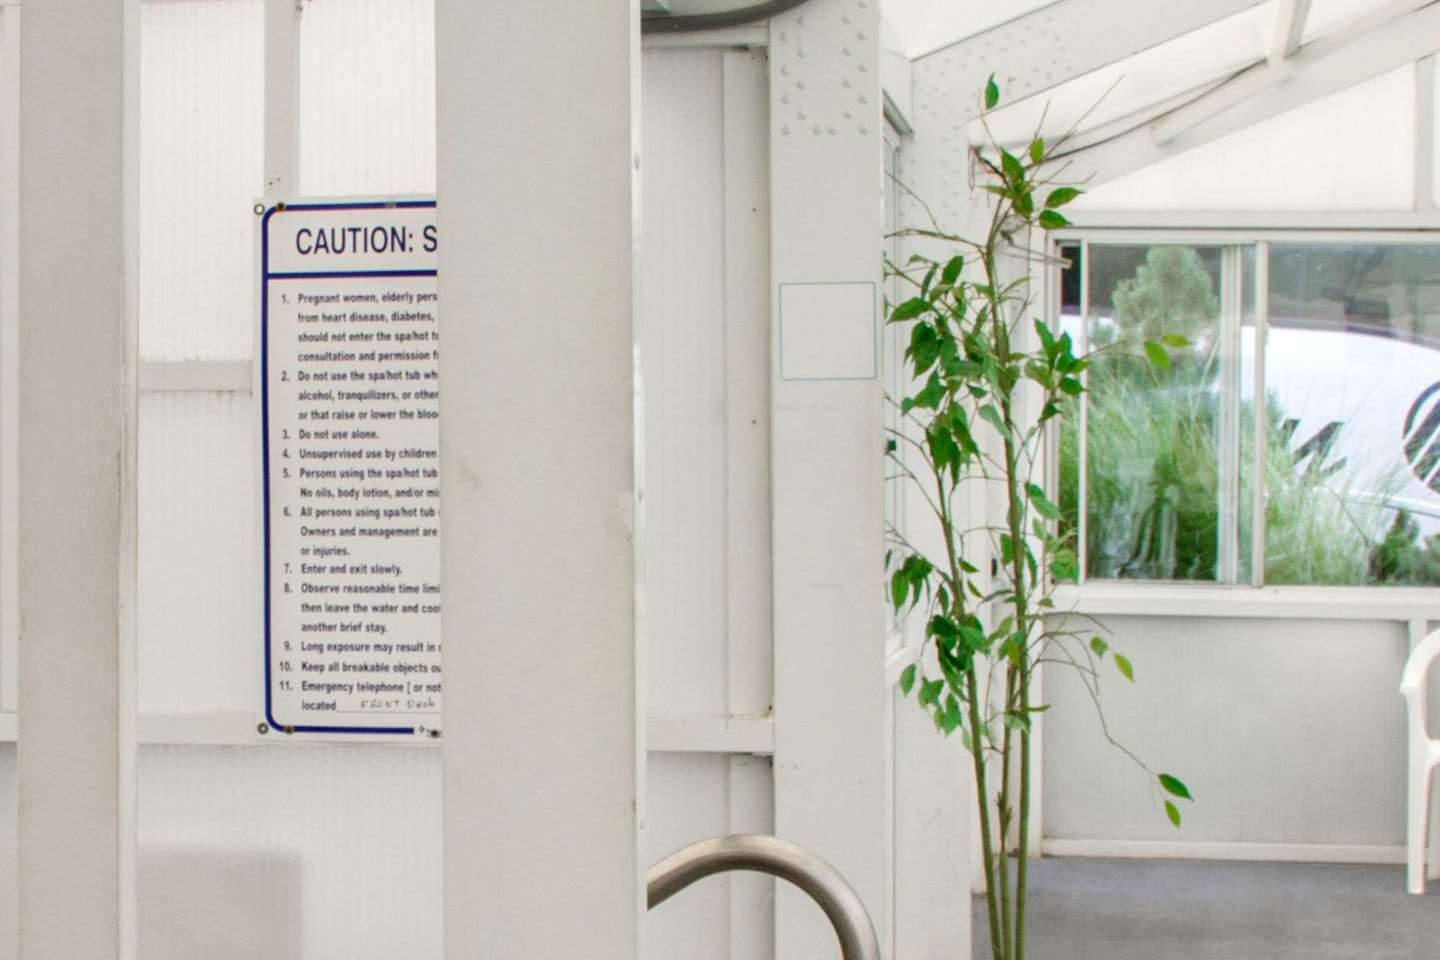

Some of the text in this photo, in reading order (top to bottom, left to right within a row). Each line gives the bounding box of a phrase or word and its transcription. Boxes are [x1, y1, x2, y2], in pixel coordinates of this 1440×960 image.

[296, 225, 414, 256] CAUTION:
[297, 293, 340, 306] Pregnant
[342, 294, 379, 303] women,
[381, 292, 414, 304] elderly
[297, 311, 435, 323] from heart disease, diabetes,
[297, 332, 329, 342] should
[330, 332, 347, 342] not
[348, 332, 374, 342] enter
[376, 331, 392, 341] the
[297, 352, 356, 362] consultation
[358, 351, 376, 361] and
[378, 350, 430, 363] permission
[297, 370, 311, 381] Do
[312, 372, 329, 381] not
[330, 373, 347, 381] use
[350, 370, 366, 381] the
[404, 370, 421, 380] tub
[297, 390, 439, 402] alcohol, tranquilizers, or other
[298, 412, 309, 420] or
[310, 410, 330, 420] that
[331, 409, 356, 420] raise
[358, 412, 368, 420] or
[370, 409, 397, 420] lower
[399, 409, 415, 419] the
[298, 429, 311, 439] Do
[312, 430, 329, 439] not
[331, 431, 348, 439] use
[350, 429, 381, 440] alone.
[299, 448, 363, 461] Unsupervised
[365, 451, 383, 459] use
[384, 448, 396, 461] by
[397, 448, 437, 458] children
[299, 468, 337, 478] Persons
[339, 468, 365, 481] using
[367, 468, 383, 478] the
[421, 468, 438, 478] tub
[300, 488, 313, 498] No
[315, 488, 336, 498] oils,
[337, 488, 360, 500] body
[362, 488, 393, 498] lotion,
[300, 506, 313, 517] All
[315, 509, 352, 519] persons
[354, 507, 380, 520] using
[419, 507, 436, 517] tub
[300, 526, 336, 536] Owners
[339, 526, 356, 536] and
[358, 527, 420, 539] management
[300, 545, 351, 558] or injuries.
[301, 563, 327, 574] Enter
[329, 564, 347, 574] and
[349, 564, 368, 574] exit
[370, 564, 403, 577] slowly.
[301, 582, 340, 593] Observe
[342, 584, 396, 594] reasonable
[398, 584, 420, 594] time
[300, 603, 322, 613] then
[324, 602, 351, 613] leave
[352, 603, 369, 613] the
[371, 603, 399, 613] water
[401, 603, 419, 613] and
[301, 622, 388, 635] another brief stay.
[301, 641, 324, 654] Long
[326, 643, 371, 654] exposure
[373, 644, 393, 655] may
[395, 642, 425, 652] result
[427, 642, 436, 652] in
[301, 661, 325, 674] Keep
[327, 662, 340, 672] all
[342, 662, 390, 672] breakable
[392, 662, 429, 675] objects
[301, 680, 354, 694] Emergency
[356, 682, 404, 694] telephone
[412, 684, 424, 692] or
[301, 700, 337, 711] located
